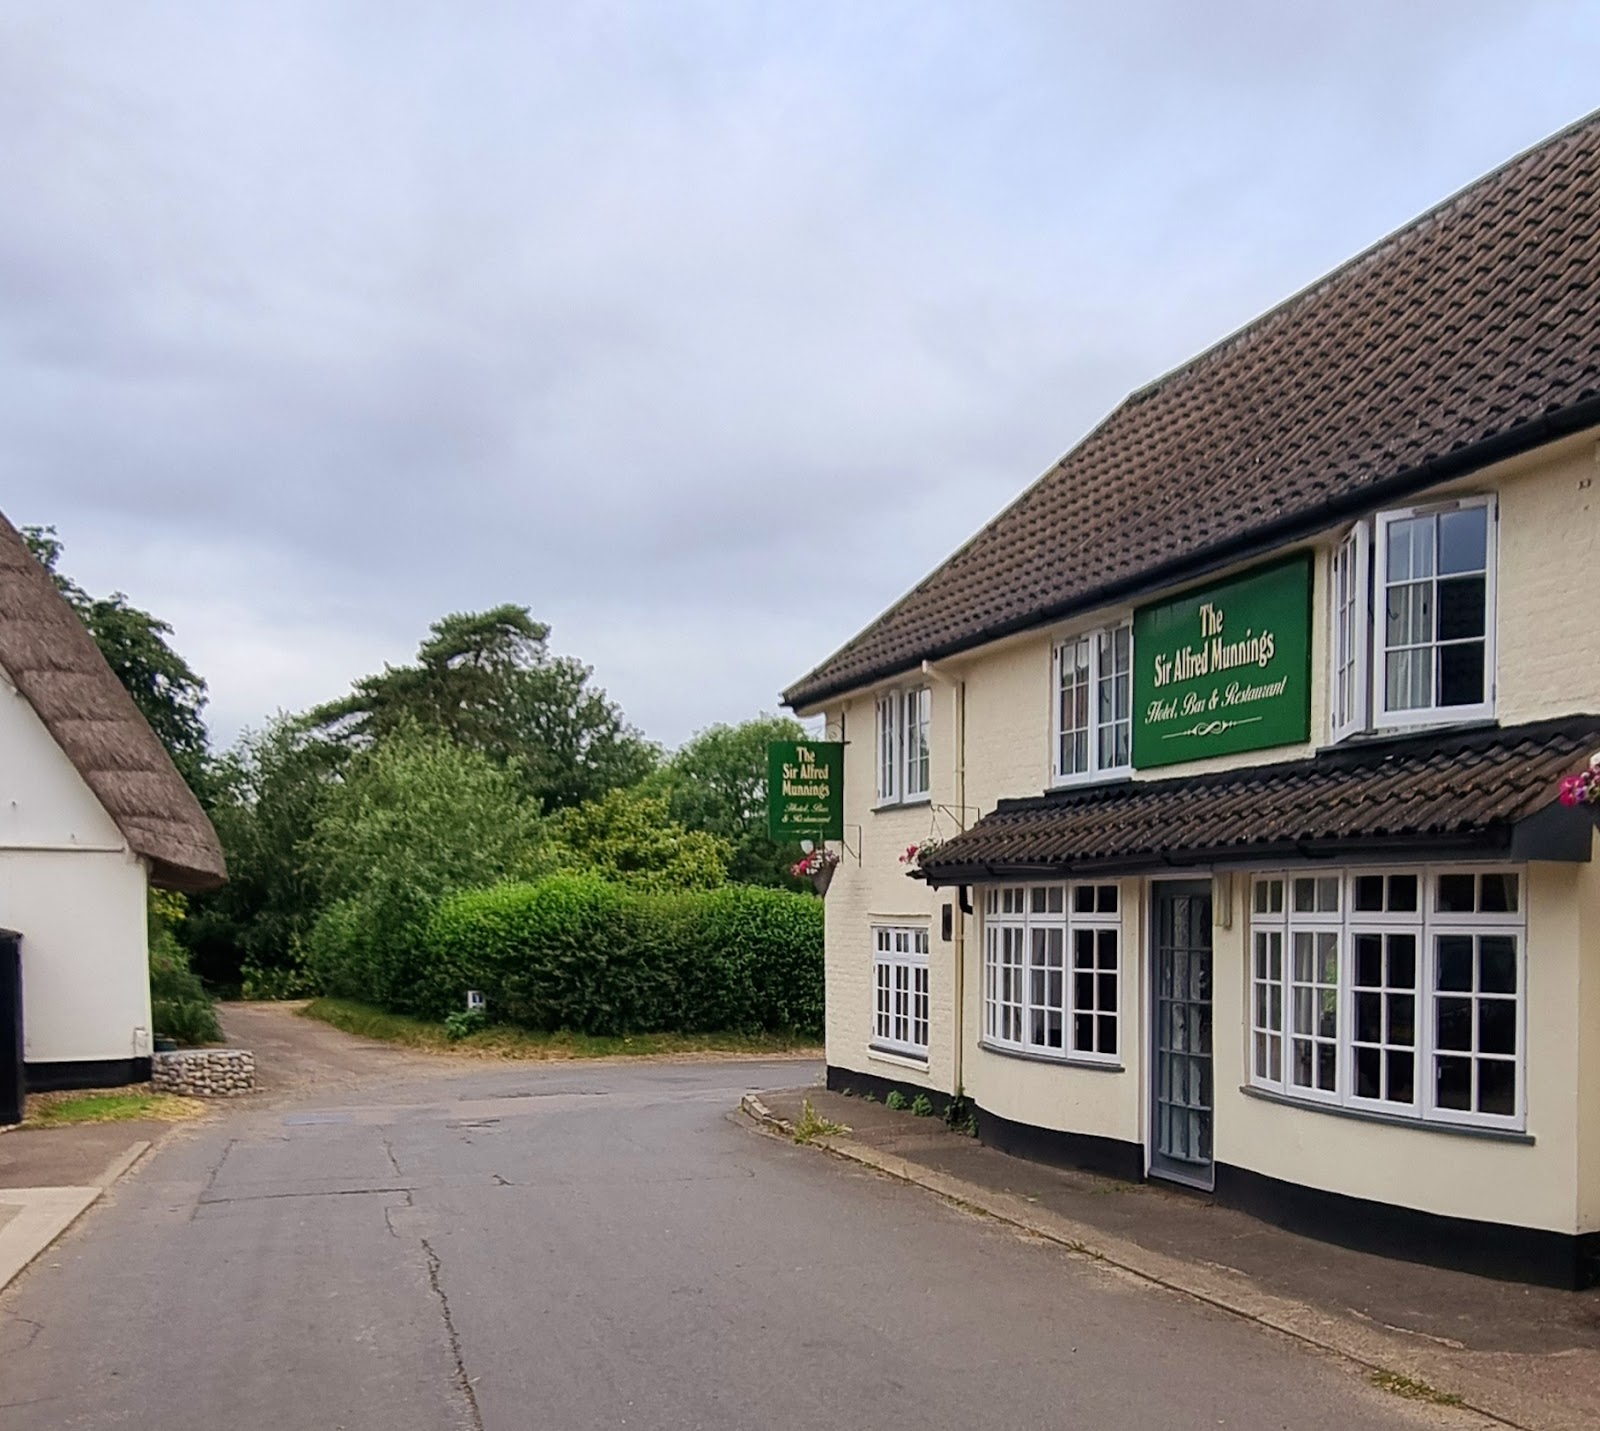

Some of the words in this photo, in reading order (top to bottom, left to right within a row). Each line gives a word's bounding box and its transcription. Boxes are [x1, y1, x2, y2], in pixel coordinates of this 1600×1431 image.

[1200, 602, 1223, 638] The
[1154, 653, 1172, 687] Sir
[1173, 641, 1208, 682] Alfred
[1210, 628, 1275, 673] Munnings
[1180, 692, 1205, 716] Bar
[1208, 688, 1219, 710] &
[1221, 675, 1287, 707] Restaurant
[796, 746, 815, 763] The
[782, 763, 799, 779] Sir
[800, 763, 829, 779] Alfred
[782, 780, 830, 799] Munnings
